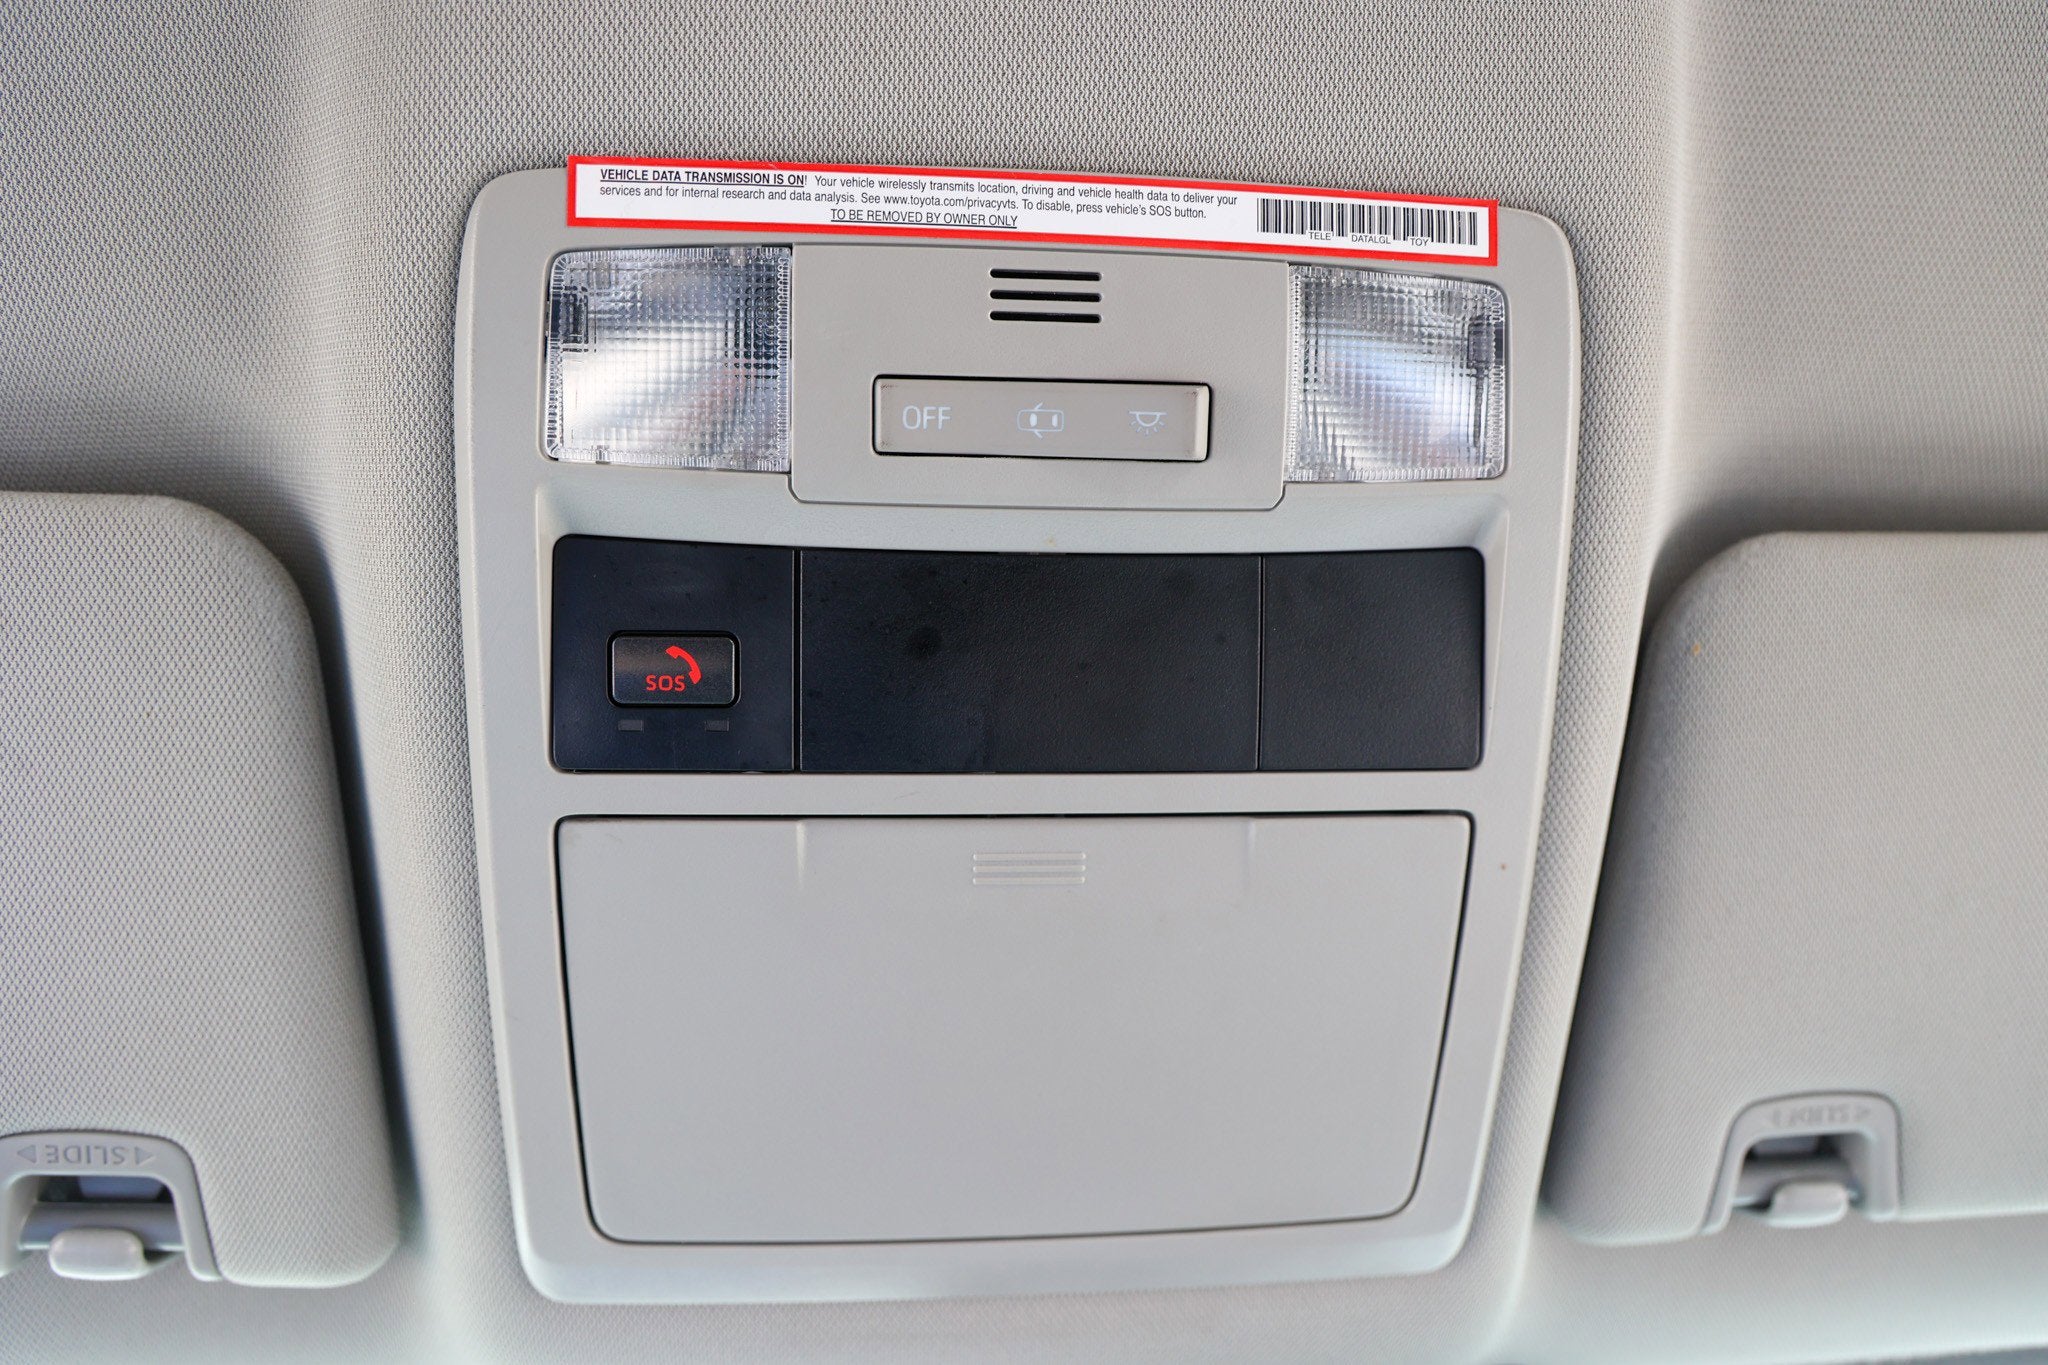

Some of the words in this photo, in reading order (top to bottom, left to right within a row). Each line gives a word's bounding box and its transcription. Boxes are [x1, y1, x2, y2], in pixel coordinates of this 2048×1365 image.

[600, 168, 648, 179] VEHICLE
[652, 169, 681, 180] DATA
[684, 170, 769, 183] TRANSMISSION
[773, 173, 784, 184] IS
[787, 173, 807, 185] ON!
[814, 175, 837, 186] Your
[839, 176, 874, 188] vehicle
[878, 178, 926, 190] wirelessly
[929, 180, 974, 192] transmits
[977, 181, 1018, 194] location,
[1021, 183, 1053, 196] driving
[1056, 185, 1075, 196] and
[1077, 186, 1111, 198] vehicle
[1114, 188, 1143, 200] health
[1146, 189, 1168, 201] data
[1171, 191, 1180, 202] to
[1183, 192, 1214, 203] deliver
[1216, 195, 1237, 205] your
[600, 184, 640, 196] services
[643, 185, 662, 196] and
[665, 185, 679, 196] for
[681, 186, 718, 198] internal
[722, 188, 764, 199] research
[767, 189, 786, 200] and
[789, 189, 811, 201] data
[814, 191, 857, 203] analysis.
[861, 192, 880, 204] See
[883, 194, 1018, 209] www.toyota.com/privacyvts.
[1021, 198, 1033, 210] To
[1036, 199, 1073, 213] disable,
[1076, 203, 1102, 213] press
[1105, 203, 1146, 215] vehicle's
[1149, 204, 1171, 216] SOS
[1174, 206, 1206, 218] button.
[830, 208, 845, 219] TO
[848, 209, 863, 220] BE
[866, 209, 922, 222] REMOVED
[926, 212, 941, 223] BY
[943, 212, 985, 225] OWNER
[988, 214, 1017, 226] ONLY
[1308, 231, 1332, 241] TELE
[1351, 234, 1391, 245] DATALGL
[1410, 236, 1429, 247] TOY
[902, 405, 951, 430] OFF
[645, 674, 686, 692] SOS
[45, 1144, 129, 1164] SLIDE
